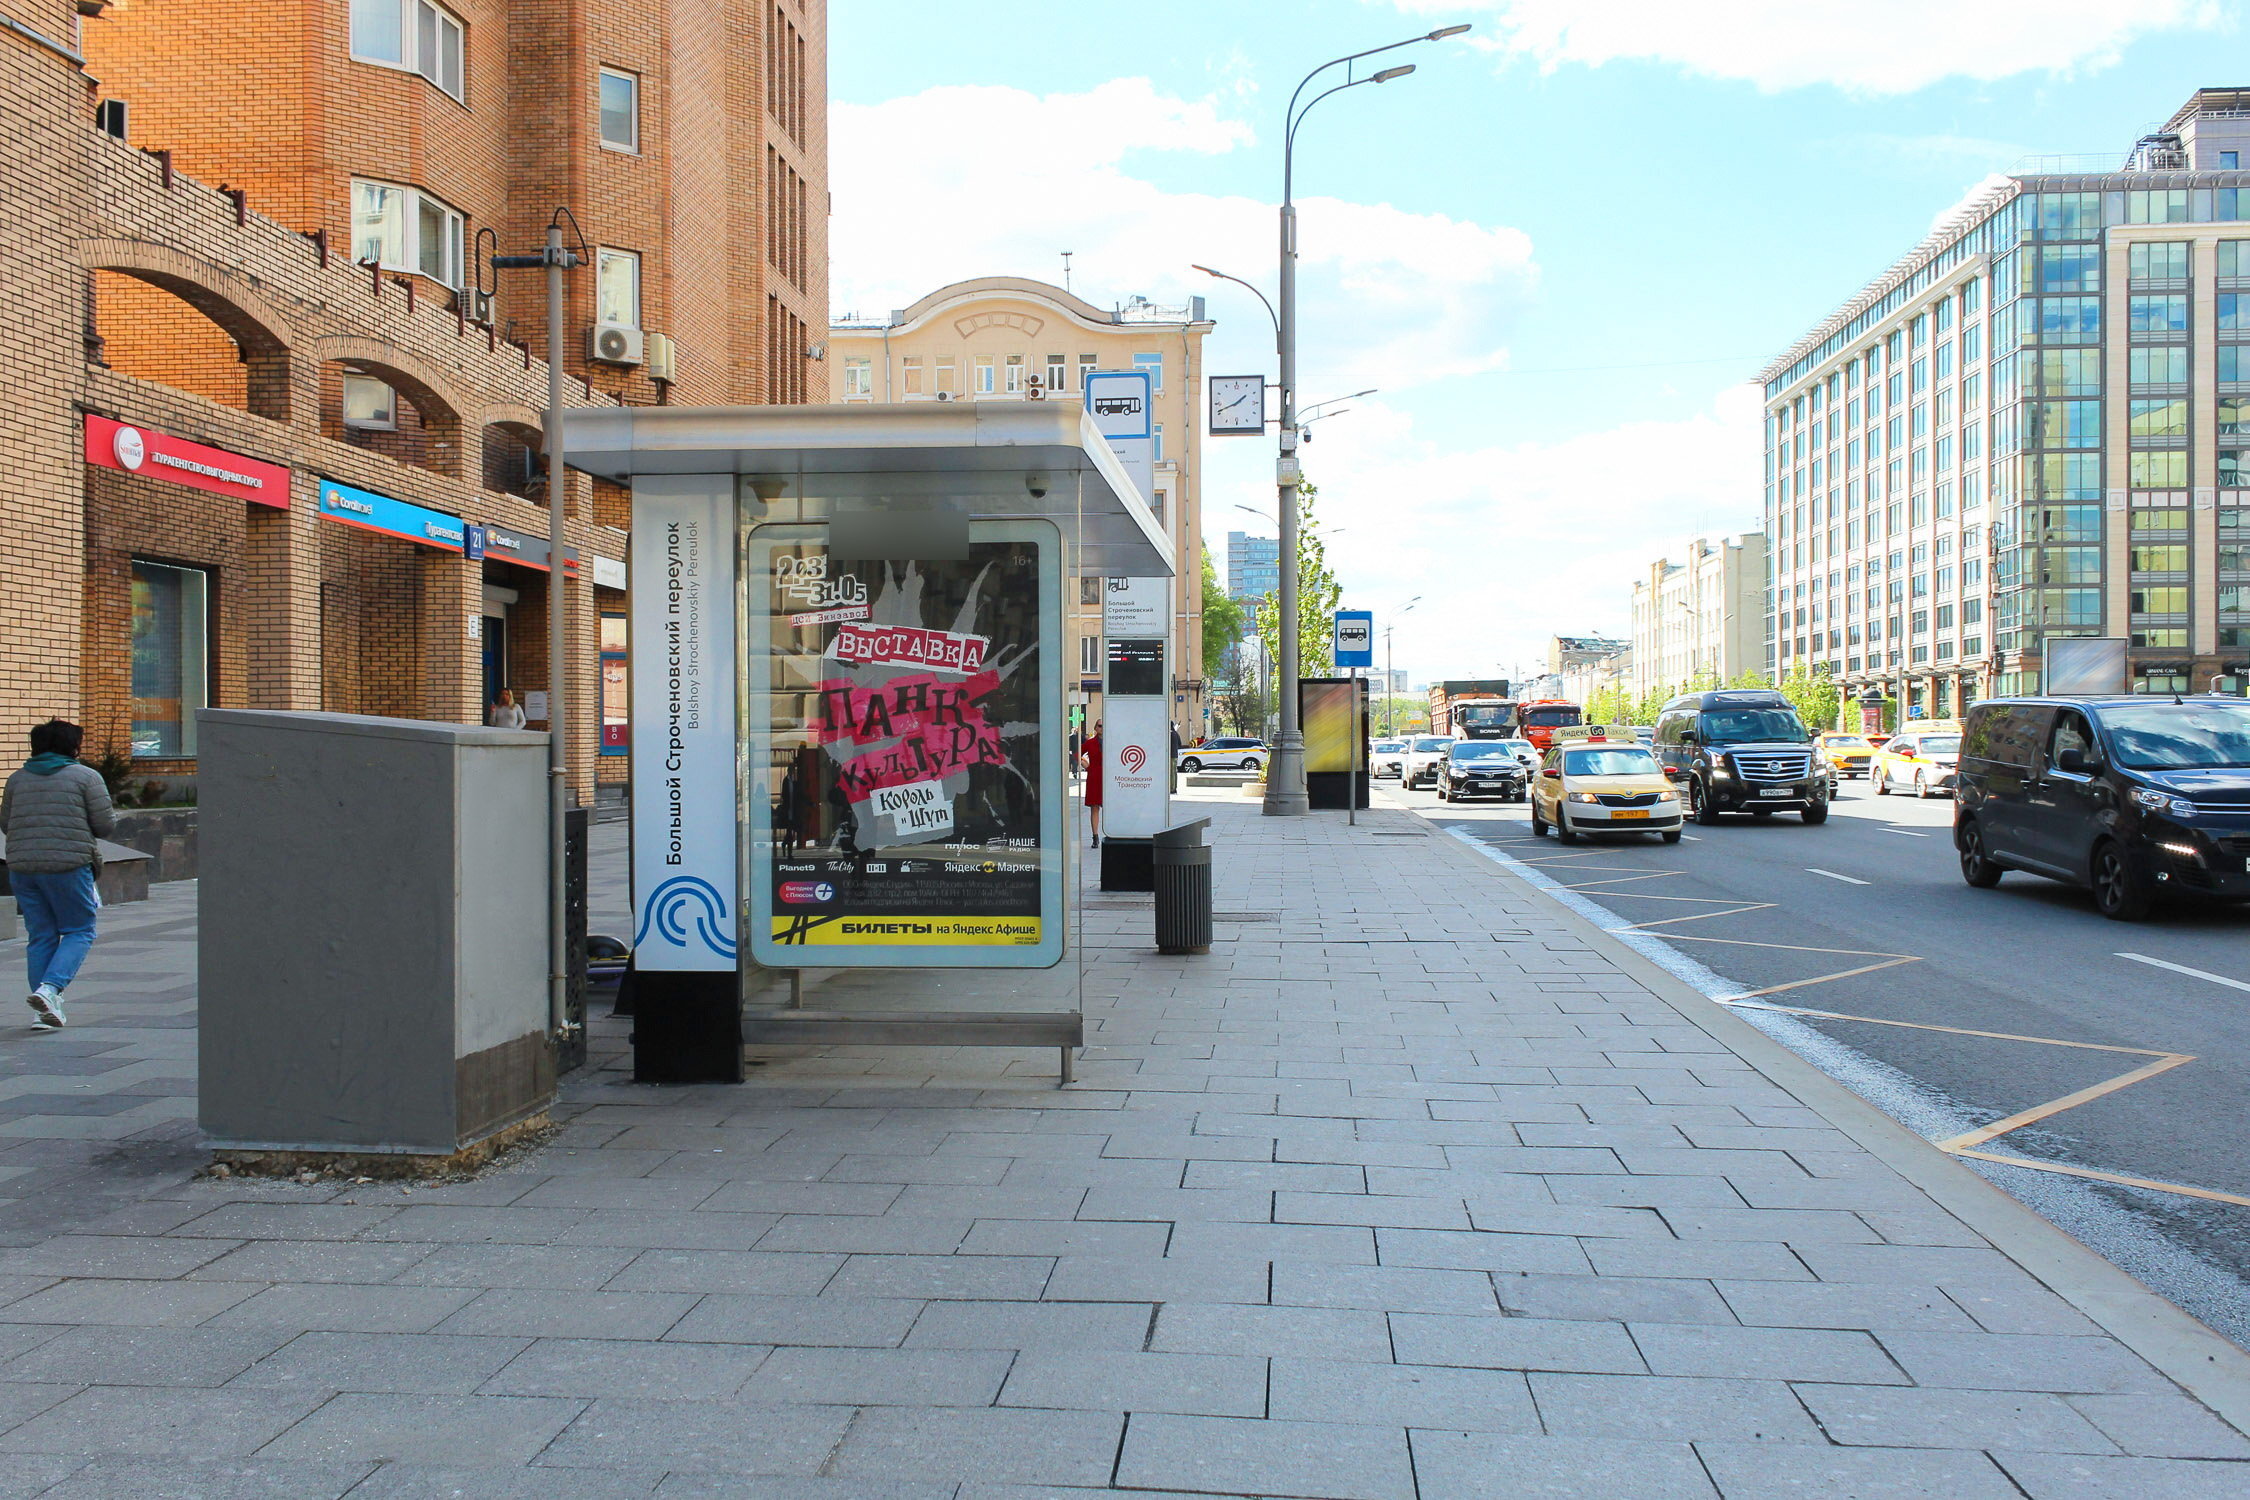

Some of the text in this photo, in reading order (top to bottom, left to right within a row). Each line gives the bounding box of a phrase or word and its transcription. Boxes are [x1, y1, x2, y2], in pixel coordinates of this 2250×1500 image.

[153, 452, 263, 489] ТУРАГЕНТСТВО ВЫГОДНЫХ ТУРОВ
[425, 521, 464, 541] Турагентство
[472, 532, 482, 549] 21
[1012, 555, 1033, 566] 16+
[686, 521, 700, 729] Bolshoy Strochenovskiy Pereulok
[838, 632, 981, 668] ВЫСТАВКА
[665, 522, 684, 865] Большой Строченовский переулок
[820, 682, 969, 737] ПАНК
[1560, 726, 1630, 738] Яндекс Go Такси
[1009, 838, 1036, 847] НАШЕ
[944, 862, 981, 873] Яндекс
[997, 862, 1036, 873] Маркет
[842, 923, 1036, 936] БИЛЕТЫ на Яндекс Афише
